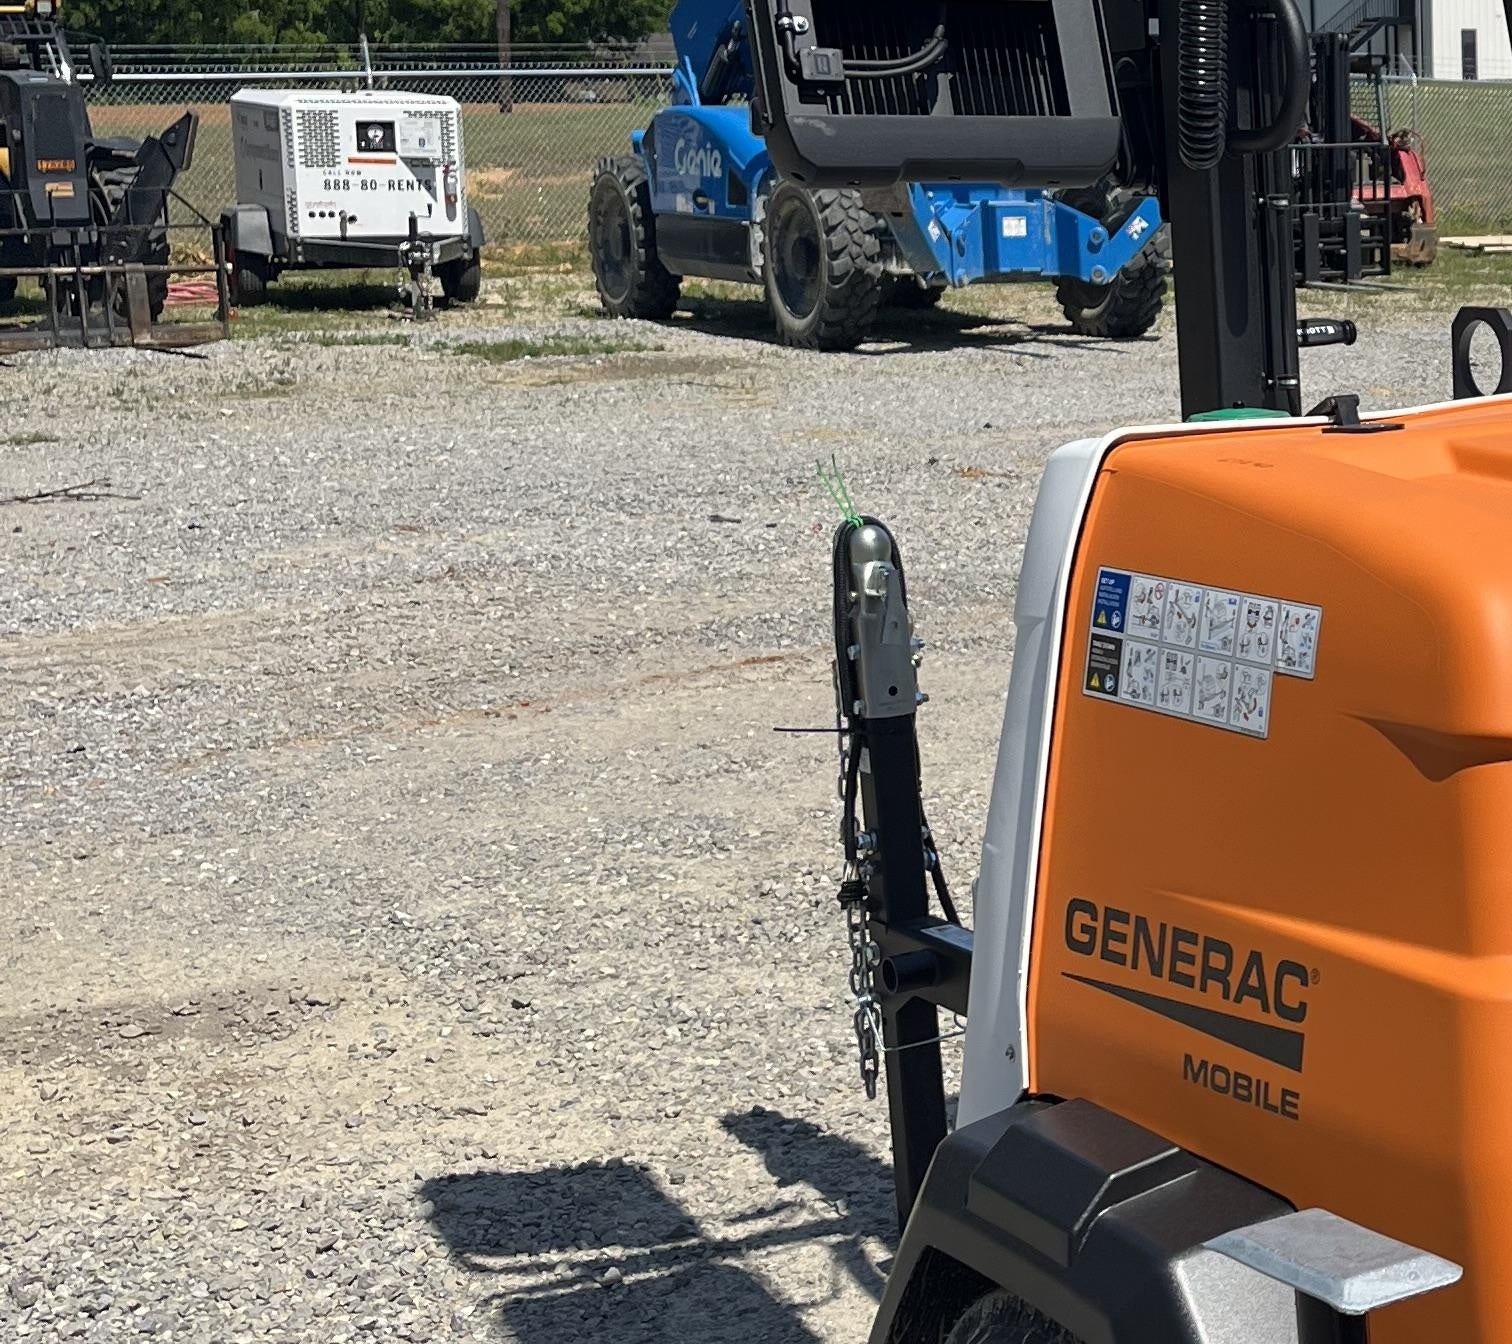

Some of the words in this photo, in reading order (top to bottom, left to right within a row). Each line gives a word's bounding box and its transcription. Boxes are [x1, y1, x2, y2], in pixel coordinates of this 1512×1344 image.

[674, 138, 722, 178] Genie
[1065, 897, 1309, 1024] GENERAC
[1183, 1053, 1300, 1121] MOBILE
